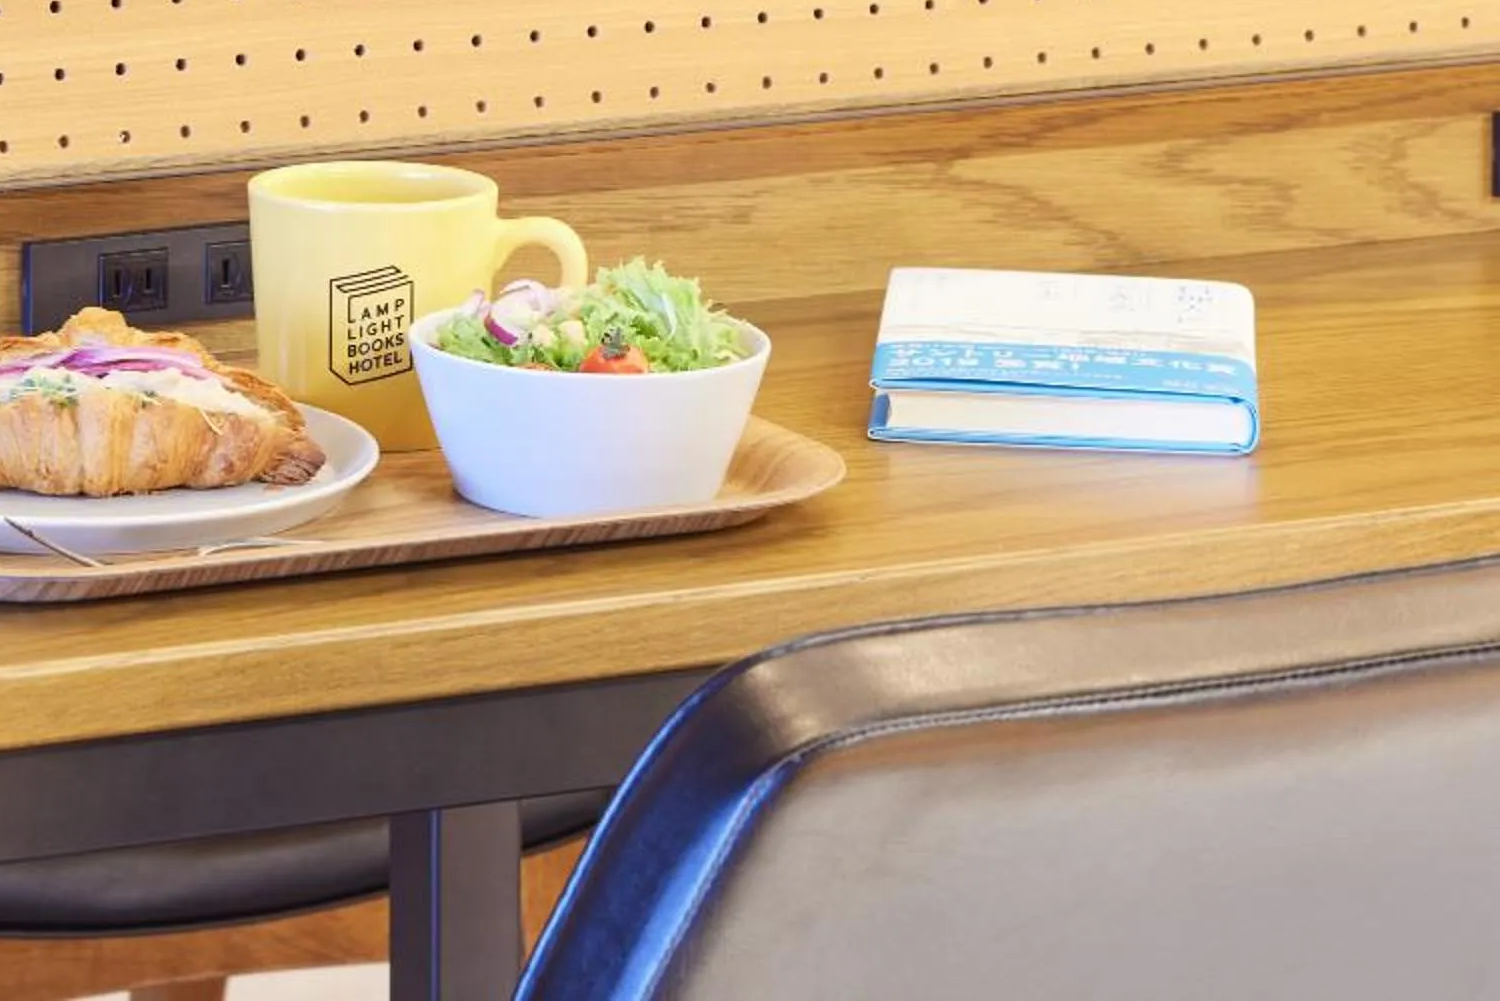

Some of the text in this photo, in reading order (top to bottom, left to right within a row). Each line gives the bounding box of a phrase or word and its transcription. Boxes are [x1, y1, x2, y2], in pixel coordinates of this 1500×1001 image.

[347, 297, 405, 324] LAMP
[347, 314, 405, 341] LIGHT
[347, 332, 405, 358] BOOKS
[348, 350, 403, 376] HOTEL
